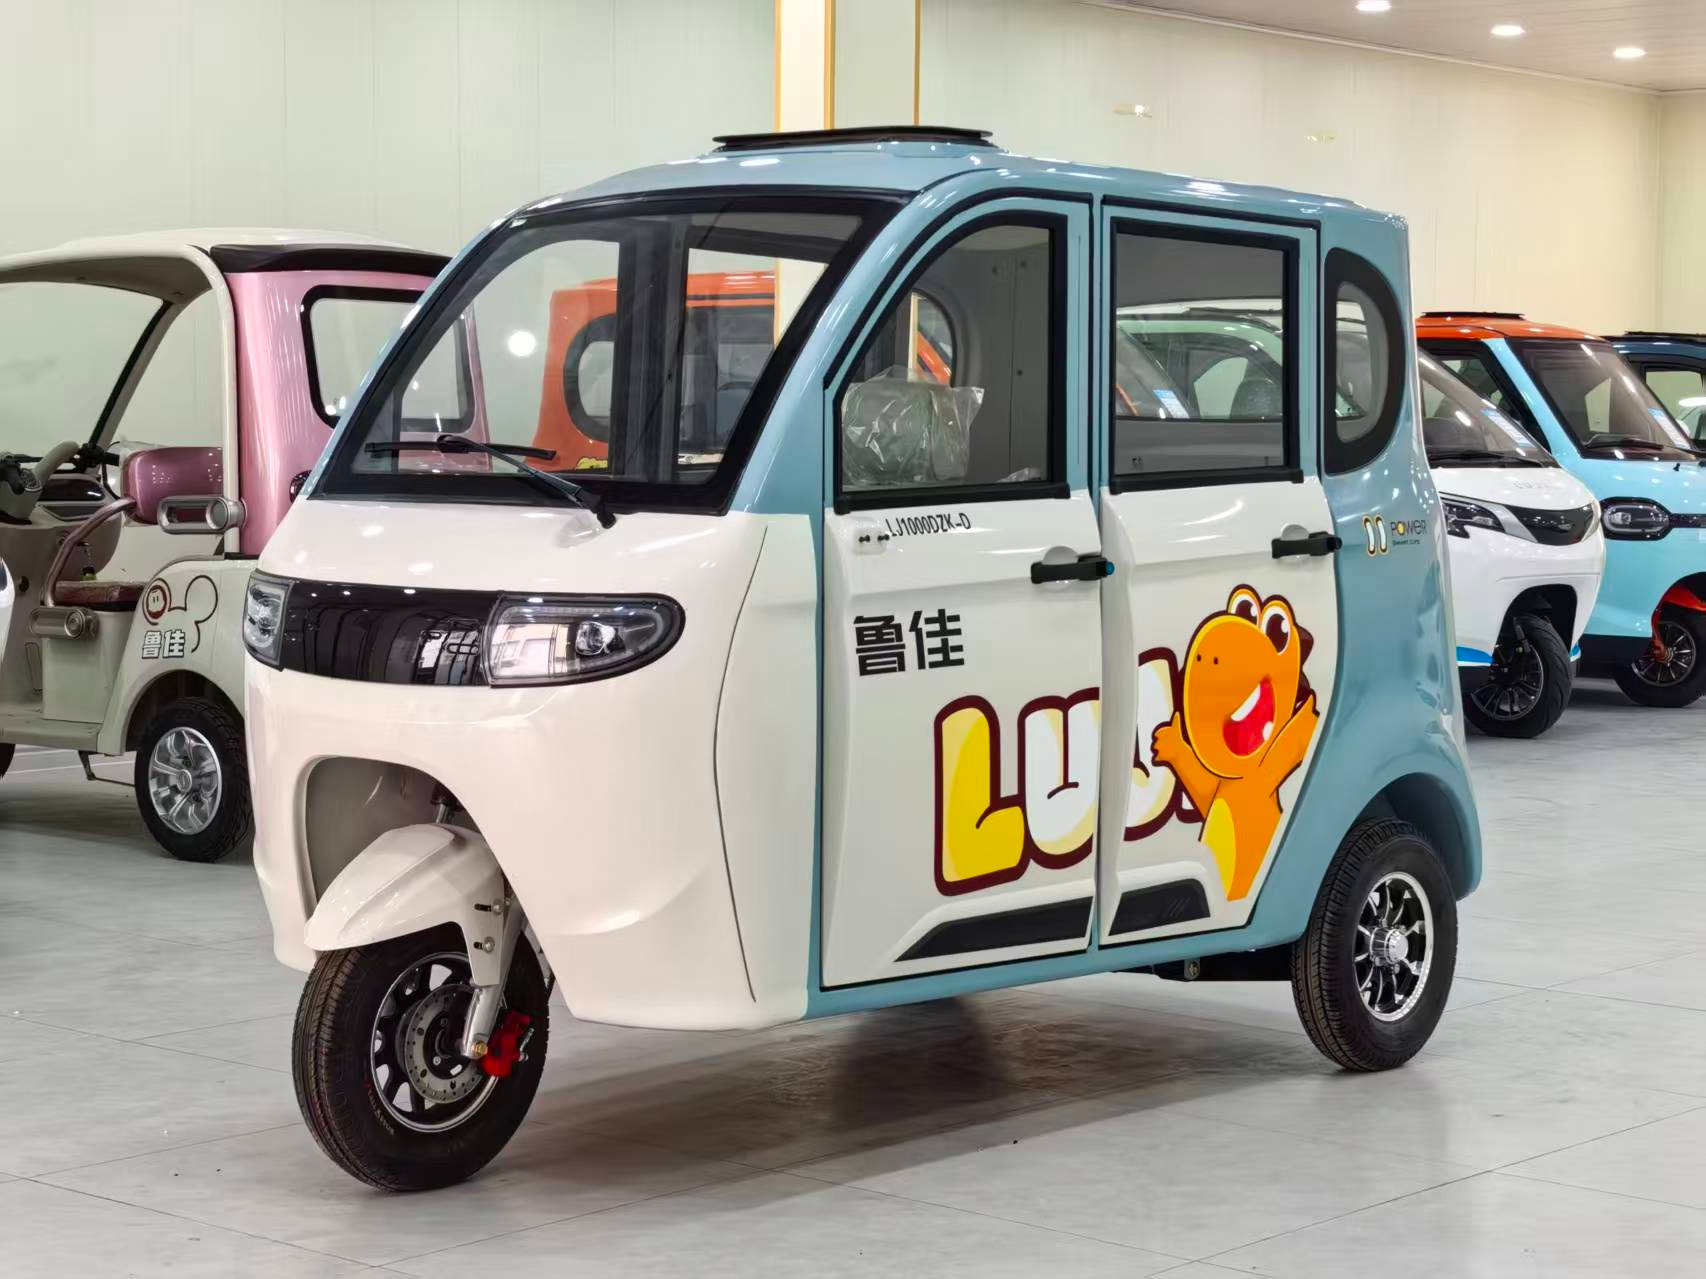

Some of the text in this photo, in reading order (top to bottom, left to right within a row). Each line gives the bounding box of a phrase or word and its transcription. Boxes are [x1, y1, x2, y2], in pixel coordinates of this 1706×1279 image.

[884, 512, 972, 537] LJ1000DZK-D
[141, 628, 187, 660] 鲁佳
[853, 608, 965, 676] 鲁佳
